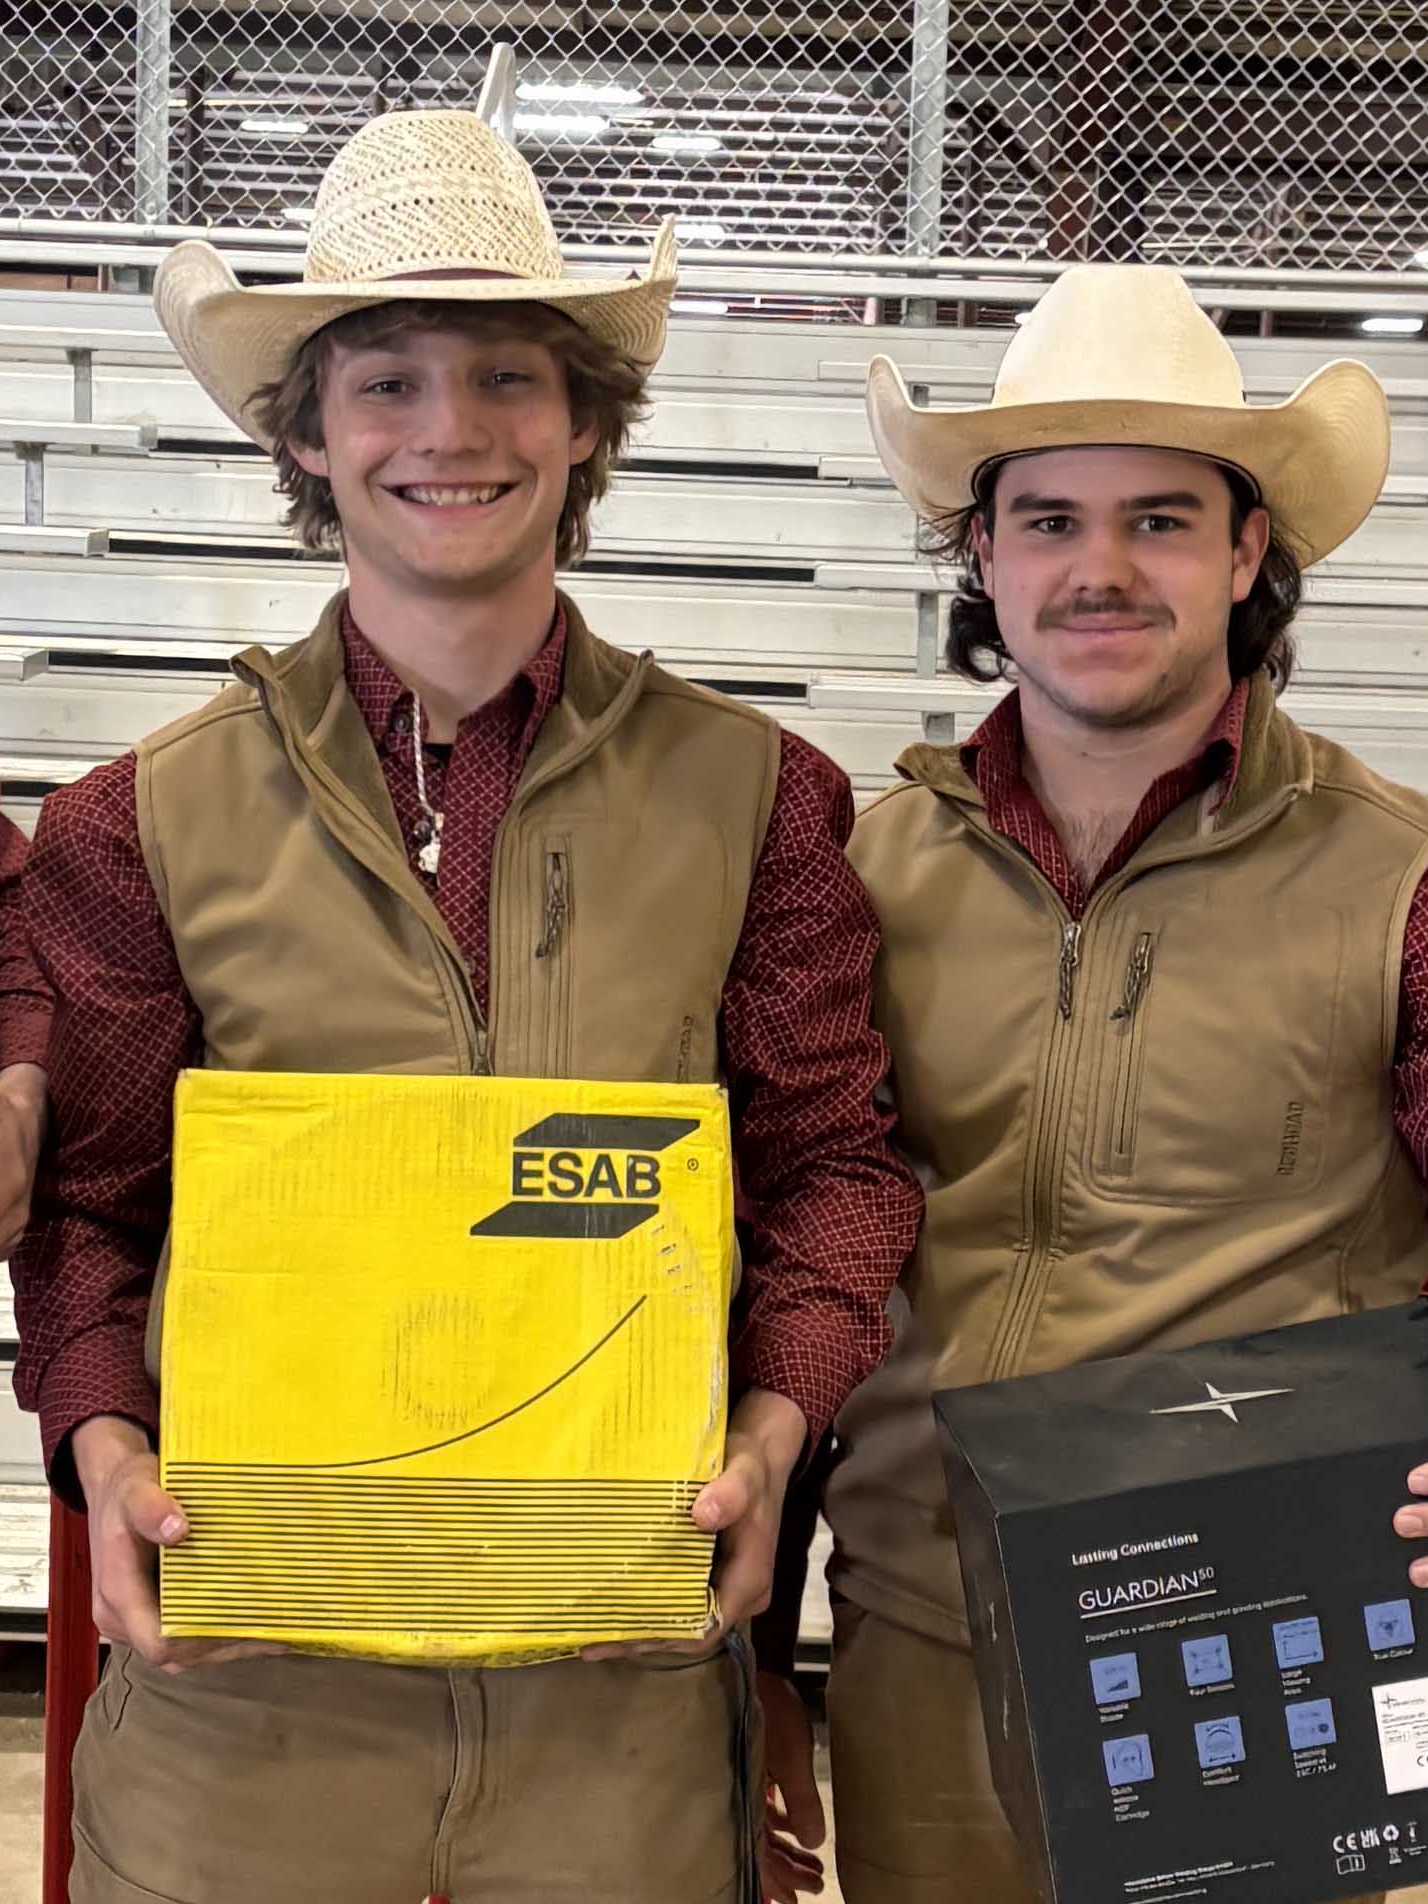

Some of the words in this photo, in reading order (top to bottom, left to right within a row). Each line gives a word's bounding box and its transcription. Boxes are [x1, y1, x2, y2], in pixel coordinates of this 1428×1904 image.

[512, 1150, 661, 1199] ESAB
[1072, 1548, 1118, 1566] Lasting
[1120, 1532, 1199, 1557] Connections
